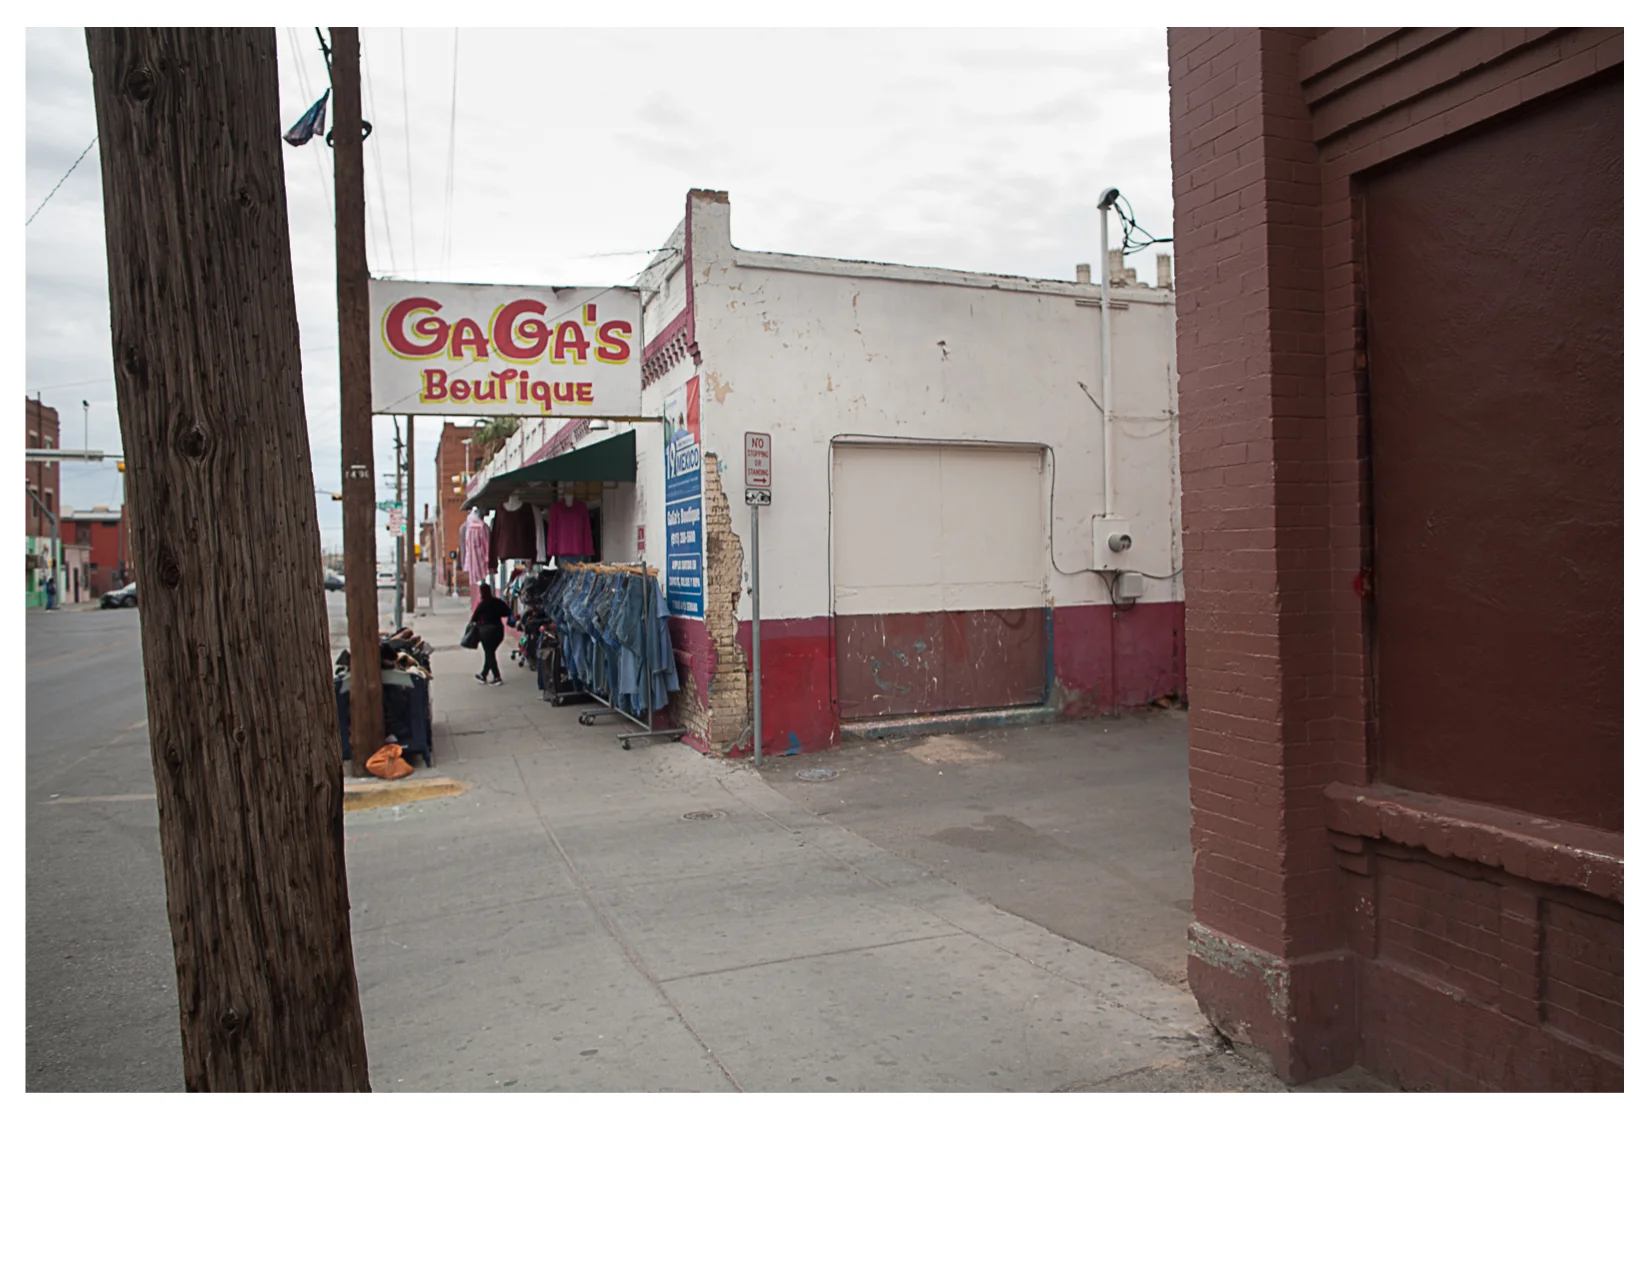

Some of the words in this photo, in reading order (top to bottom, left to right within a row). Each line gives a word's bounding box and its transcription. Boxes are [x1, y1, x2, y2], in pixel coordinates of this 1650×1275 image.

[751, 437, 764, 449] NO
[747, 449, 769, 459] STOPPING
[754, 459, 762, 467] OR
[747, 467, 769, 477] STANDING
